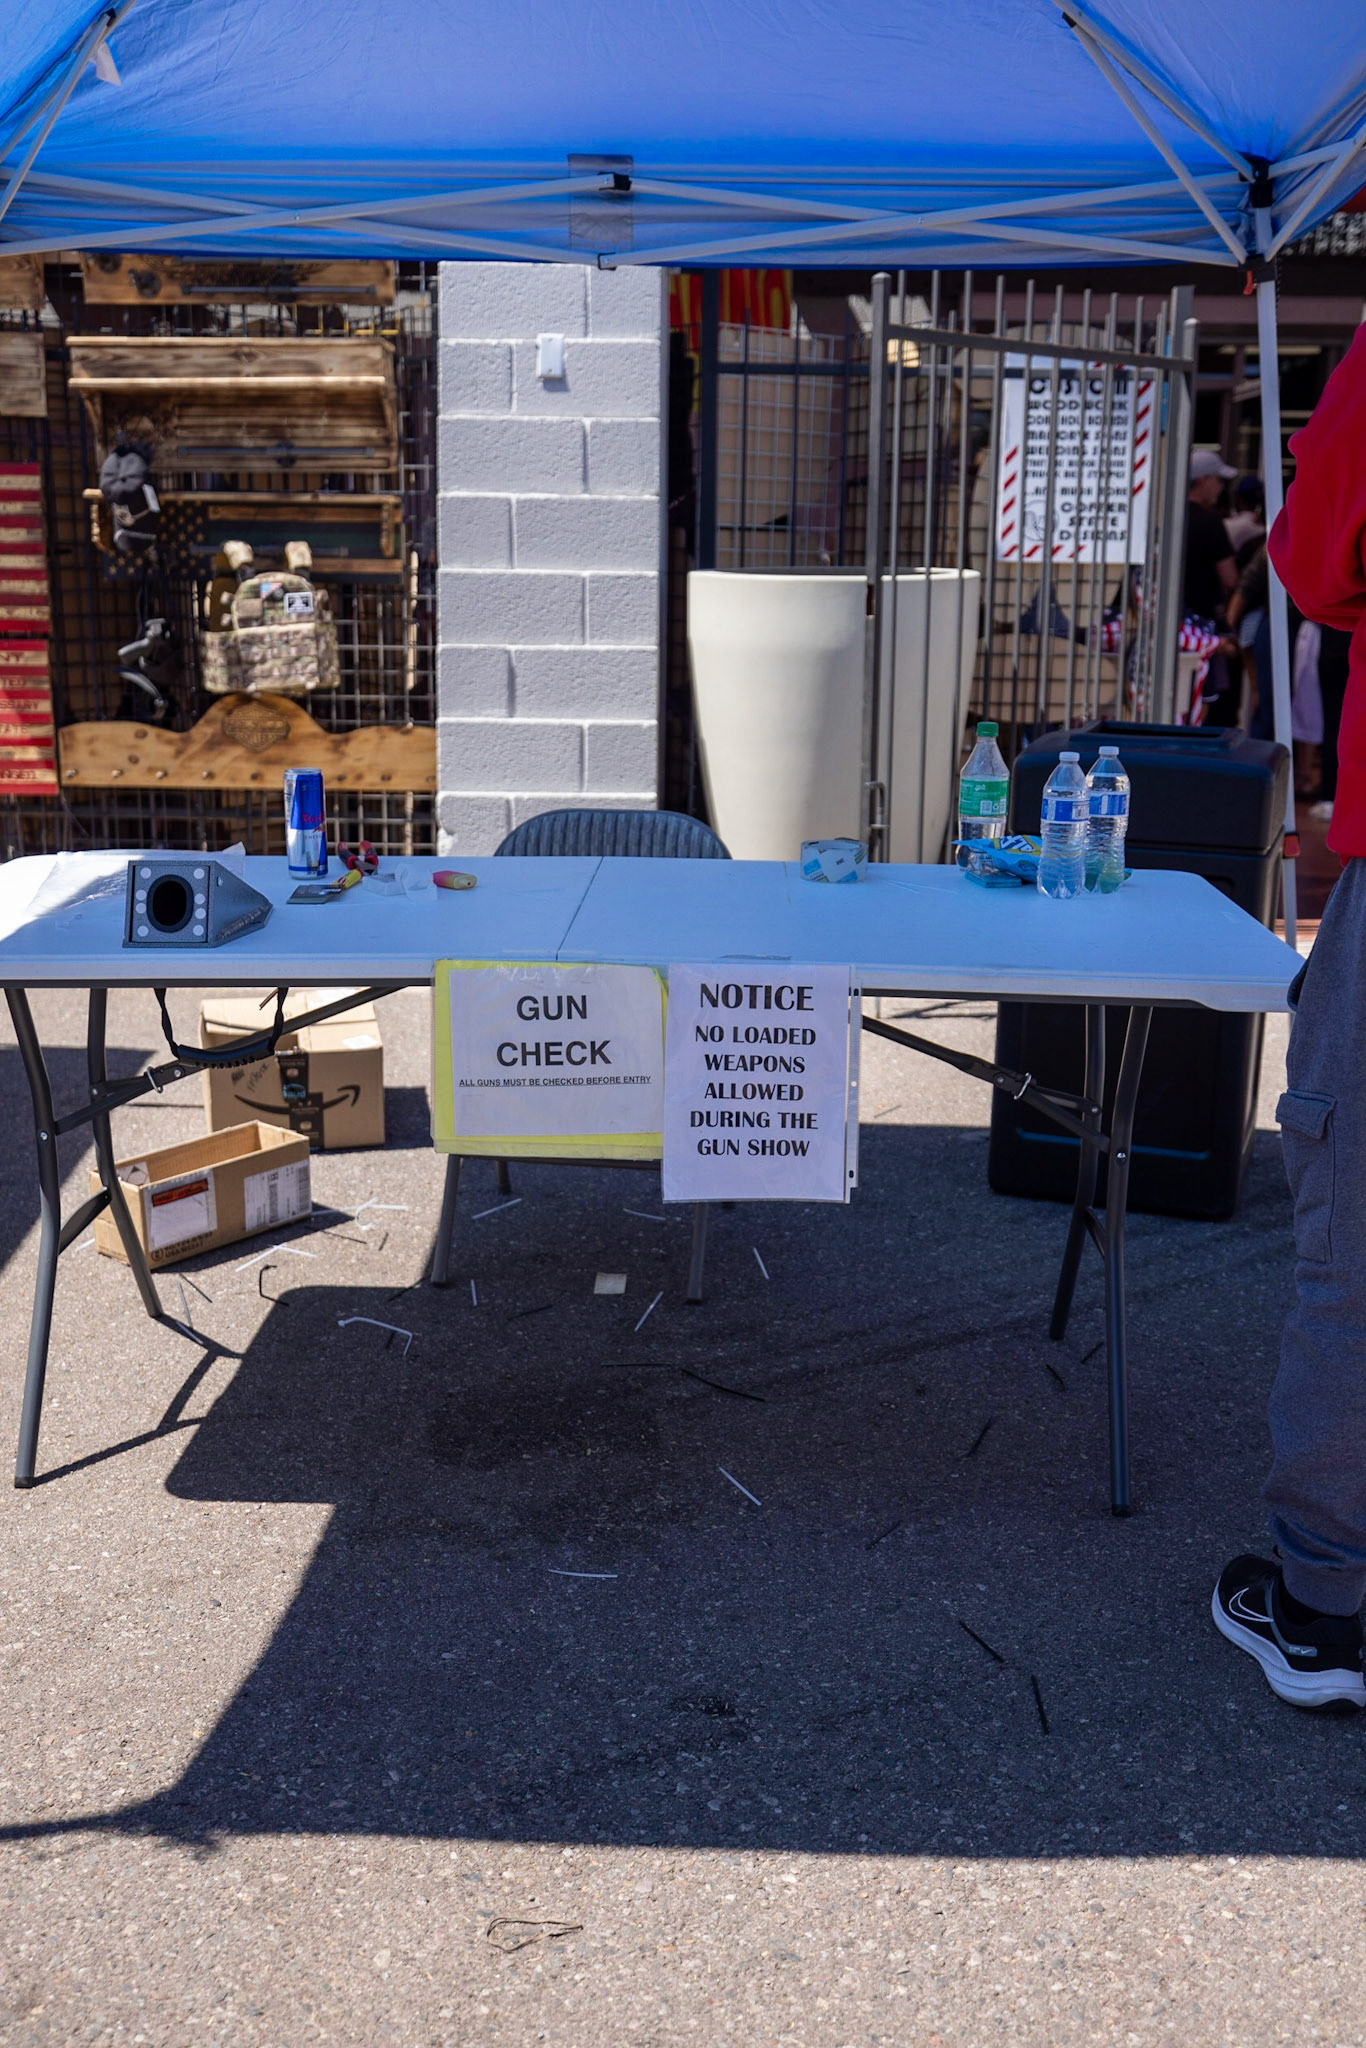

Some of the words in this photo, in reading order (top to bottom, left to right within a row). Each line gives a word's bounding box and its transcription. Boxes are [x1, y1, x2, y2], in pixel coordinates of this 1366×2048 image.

[700, 983, 814, 1012] NOTICE
[517, 995, 588, 1022] GUN
[696, 1025, 725, 1043] NO
[733, 1026, 817, 1046] LOADED
[497, 1040, 612, 1067] CHECK
[704, 1054, 806, 1074] WEAPONS
[459, 1079, 475, 1087] ALL
[477, 1079, 501, 1087] GUNS
[503, 1078, 526, 1086] MUST
[529, 1078, 541, 1086] BE
[543, 1077, 584, 1086] CHECKED
[586, 1077, 622, 1085] BEFORE
[624, 1076, 652, 1084] ENTRY
[704, 1082, 804, 1102] ALLOWED
[690, 1111, 771, 1129] DURING
[777, 1112, 818, 1130] THE
[697, 1139, 740, 1156] GUN
[748, 1139, 811, 1157] SHOW
